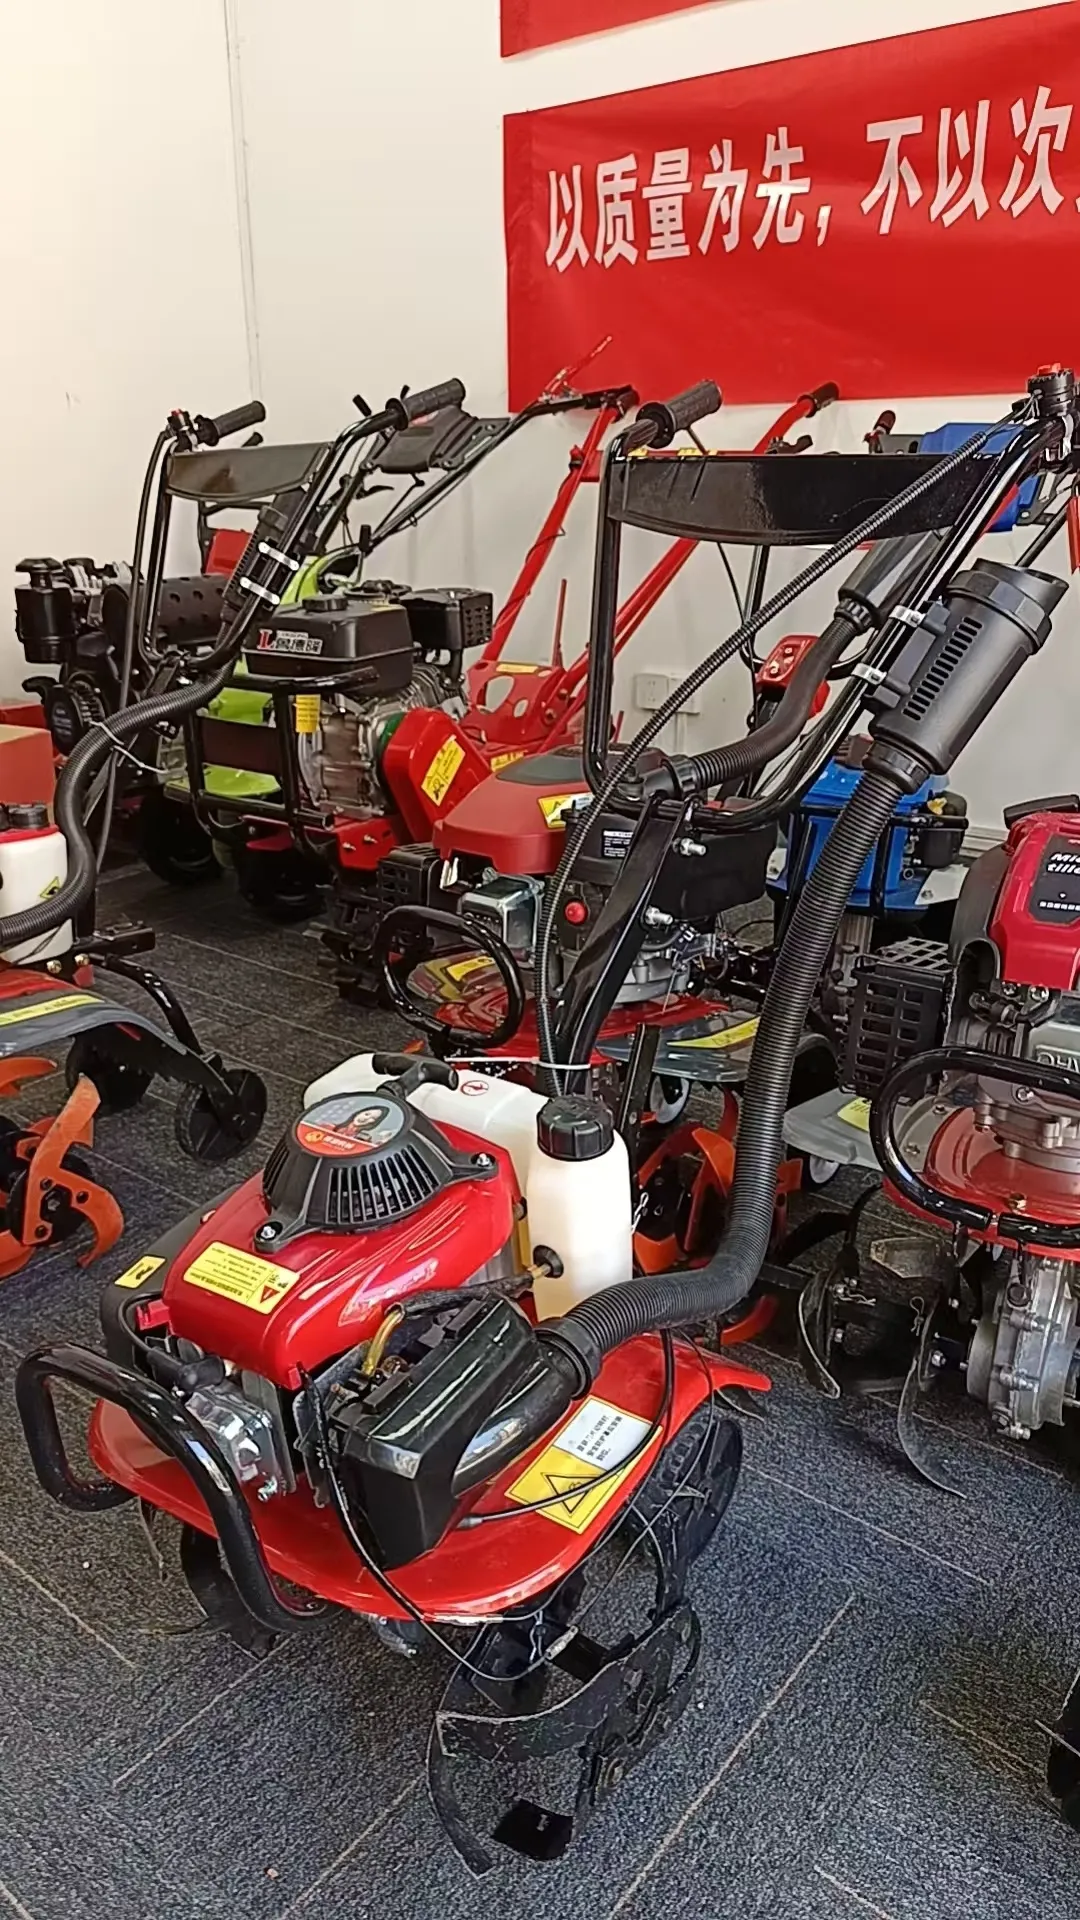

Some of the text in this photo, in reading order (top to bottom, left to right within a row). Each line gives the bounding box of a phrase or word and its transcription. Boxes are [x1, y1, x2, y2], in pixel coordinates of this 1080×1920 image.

[545, 86, 1080, 272] 以质量为先，不以次
